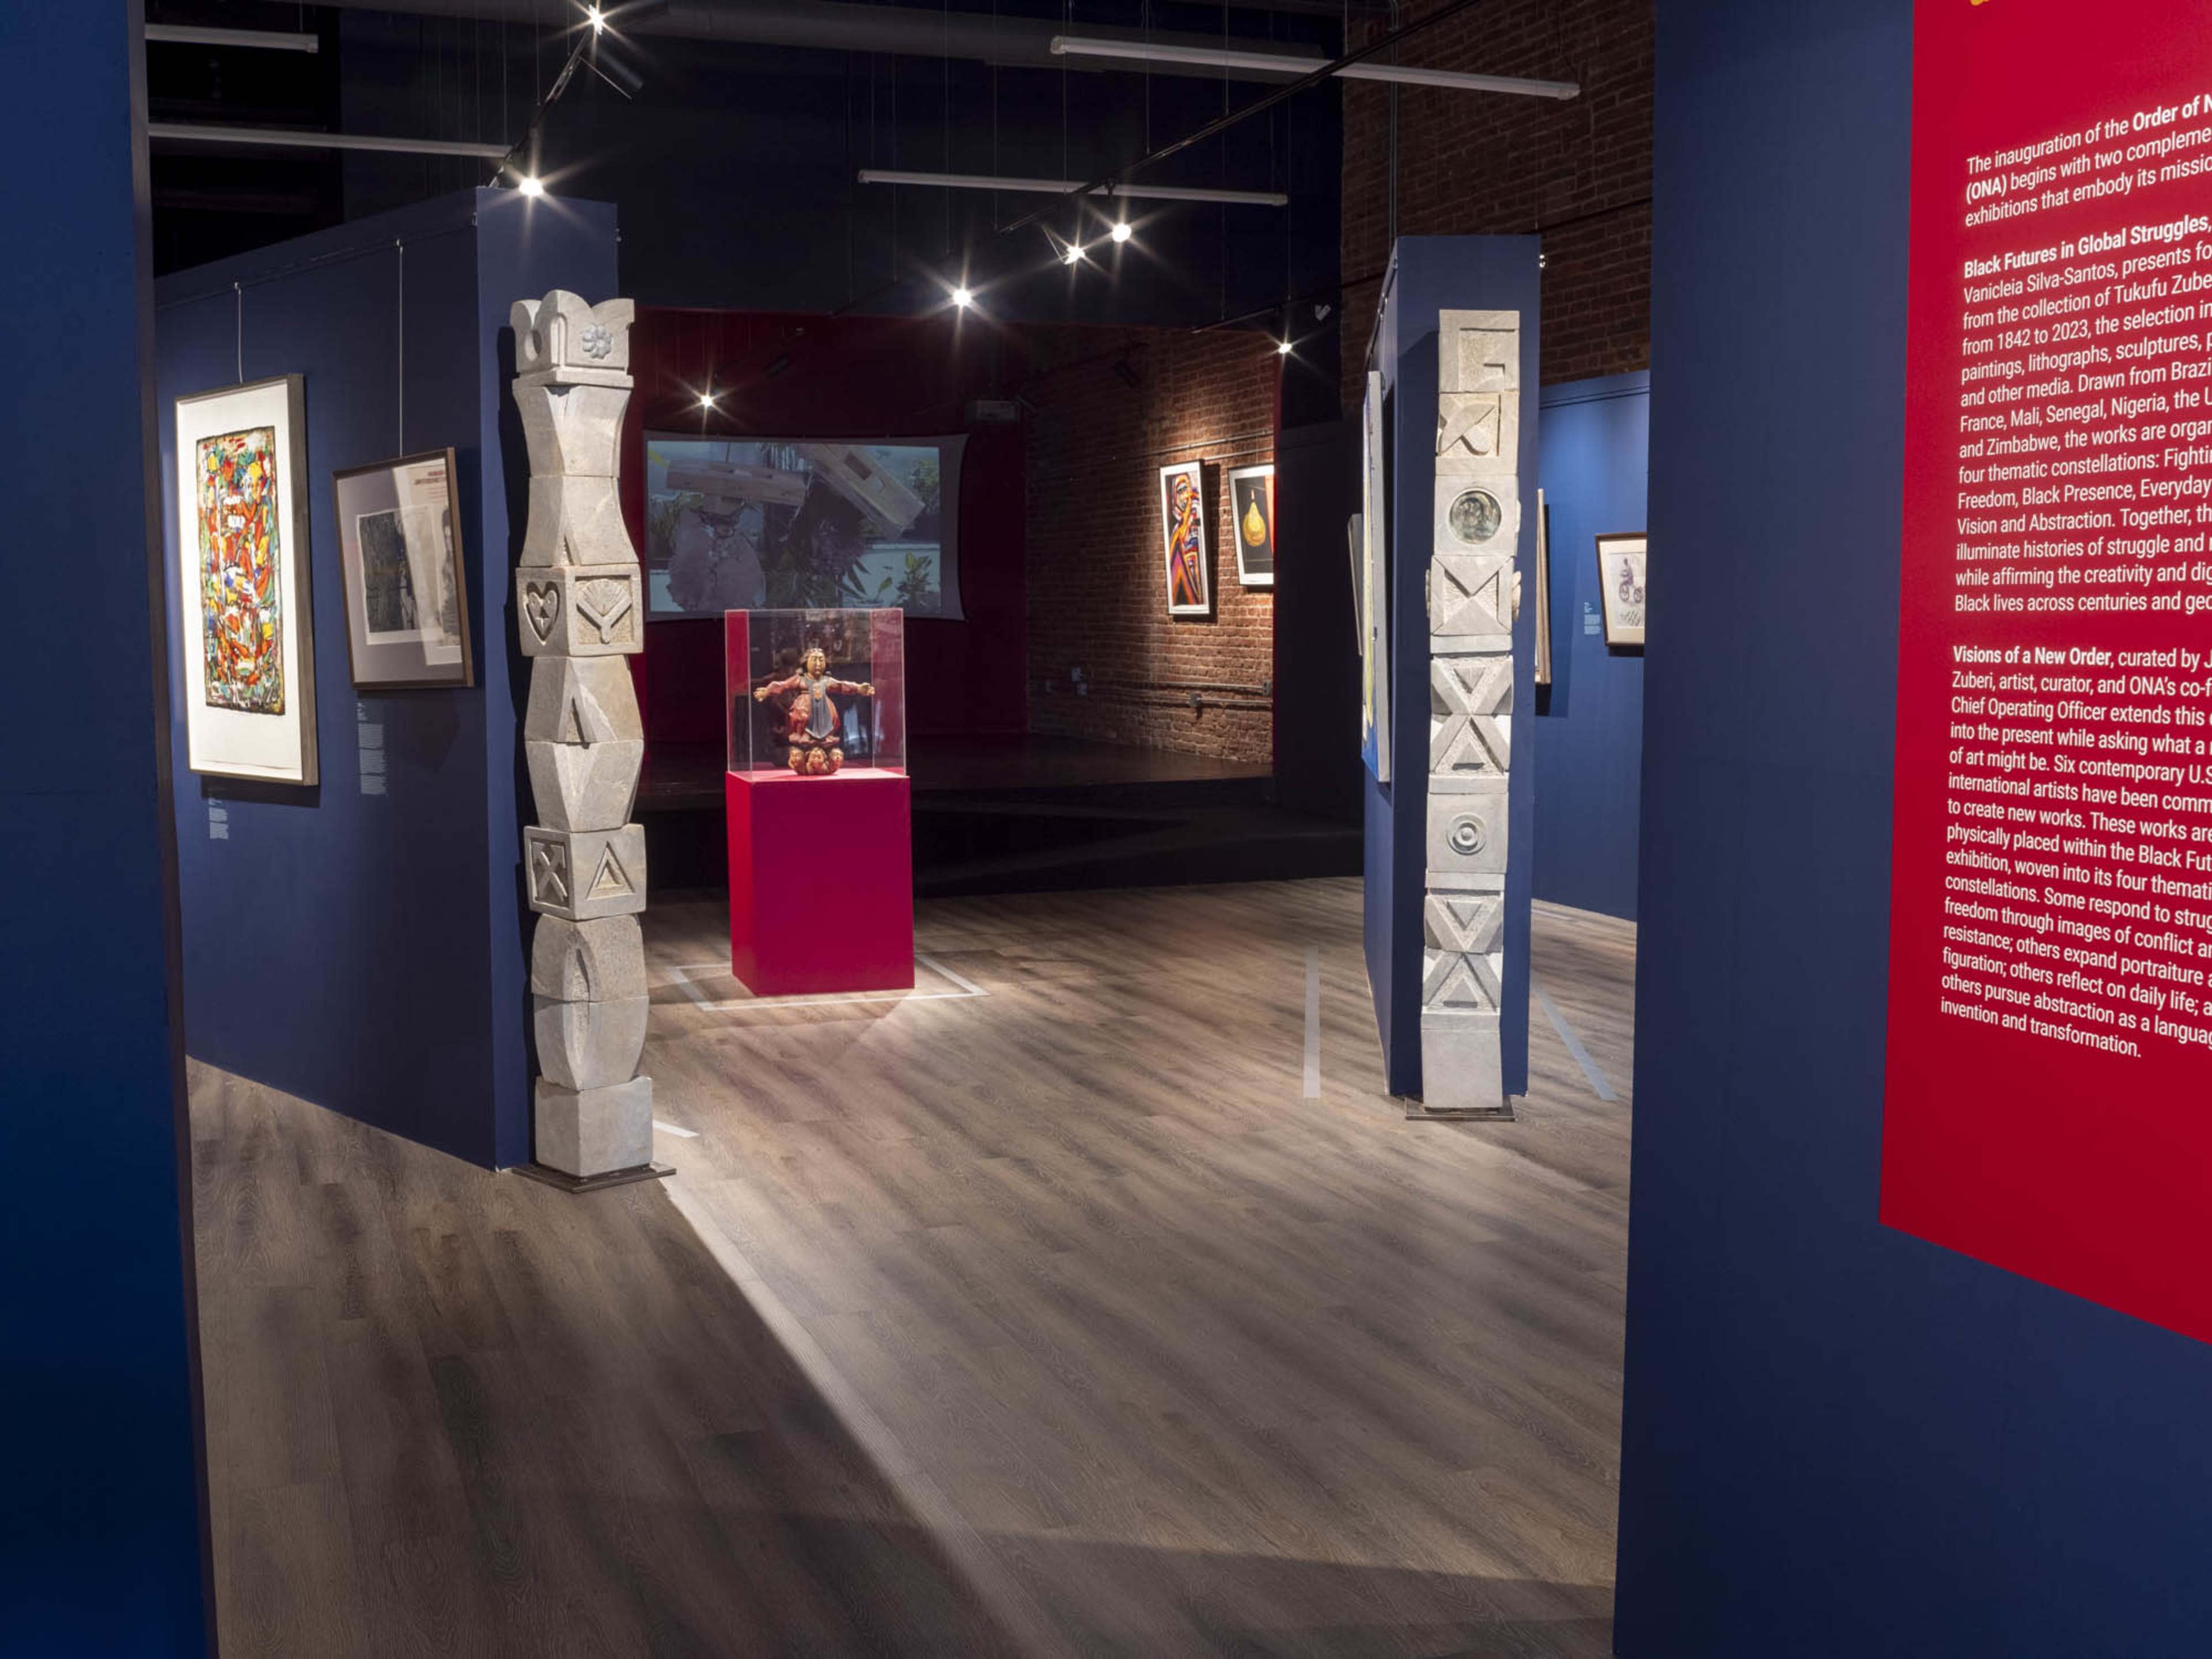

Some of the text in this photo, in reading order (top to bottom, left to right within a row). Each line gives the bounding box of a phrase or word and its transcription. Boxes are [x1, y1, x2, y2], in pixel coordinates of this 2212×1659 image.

[1967, 95, 2200, 175] The inauguration of the Order of
[1965, 150, 2123, 204] (ONA) begins with two
[1965, 169, 2156, 227] exhibitions that embody its
[1964, 214, 2212, 279] Black Futures in Global Struggles,
[1964, 248, 2191, 304] Vanicleia Silva-Santos, presents
[1963, 278, 2167, 330] from the collection of Tukufu
[1962, 305, 2195, 355] from 1842 2023, the selection
[1961, 334, 2202, 385] paintings, lithographs, sculptures,
[1961, 366, 2166, 407] and other media. Drawn from
[1960, 389, 2200, 432] France, Mali, Senegal, Nigeria, the
[1959, 425, 2166, 458] and Zimbabwe, the works are
[1959, 452, 2160, 483] four thematic constellations:
[1959, 475, 2212, 509] Freedom, Black Presence, Everyday
[1957, 505, 2192, 535] Vision and Abstraction. Together,
[1957, 532, 2205, 560] illuminate histories of struggle and
[1956, 562, 2187, 589] while affirming the creativity and
[1955, 590, 2181, 611] Black lives across centuries and
[1953, 645, 2200, 673] Visions of New Order, curated by
[1952, 671, 1995, 691] Zuberi,
[1999, 673, 2037, 693] artist,
[2040, 676, 2093, 695] curator,
[2097, 675, 2126, 694] and
[1952, 696, 2205, 726] Chief Operating Officer extends this
[1950, 721, 2191, 756] into the present while asking what
[1949, 747, 2186, 787] of art might be. Six contemporary
[1949, 772, 2158, 808] international artists have been
[1947, 798, 2187, 839] to create new works. These works
[1947, 823, 2181, 868] physically placed within the Black
[1946, 849, 2147, 891] exhibition, woven into its four
[1945, 876, 2171, 923] constellations. Some respond to
[1945, 896, 2194, 955] freedom through images of conflict
[1944, 926, 2203, 985] resistance; others expand portraiture
[1942, 946, 2199, 1016] figuration; others reflect on daily life;
[1942, 974, 2137, 1028] others pursue abstraction as
[1941, 997, 2141, 1057] invention and transformation.
